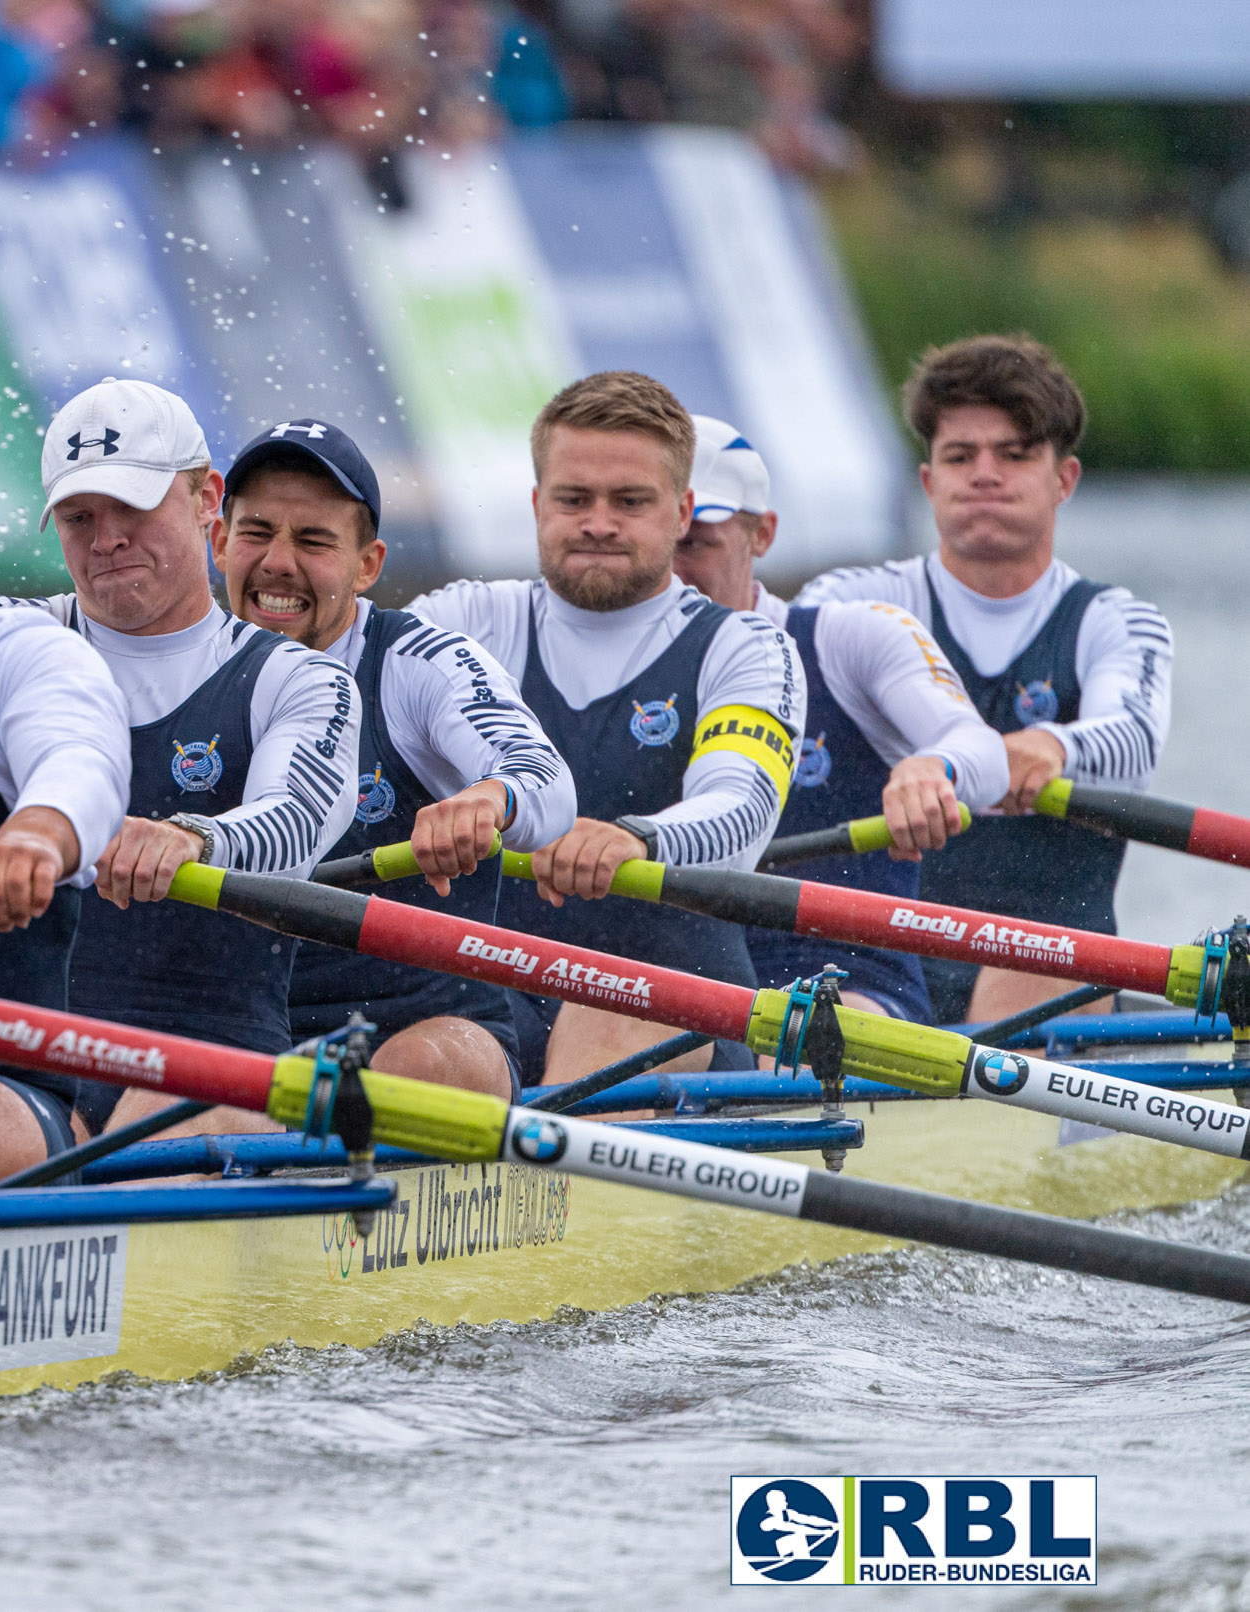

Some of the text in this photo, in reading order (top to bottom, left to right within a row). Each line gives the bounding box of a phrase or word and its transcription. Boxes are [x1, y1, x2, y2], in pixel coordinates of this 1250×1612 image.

[776, 632, 794, 720] Germana
[889, 907, 1077, 955] Body Attack
[970, 938, 1074, 965] SPORTS NUTRITION
[457, 935, 654, 998] Body Attack
[541, 974, 651, 1009] SPORTS NUTRITION
[46, 1029, 168, 1073] Attack
[1047, 1072, 1245, 1134] EULER GROUP
[589, 1140, 801, 1201] EULER GROUP
[417, 1163, 502, 1265] Ulbricht
